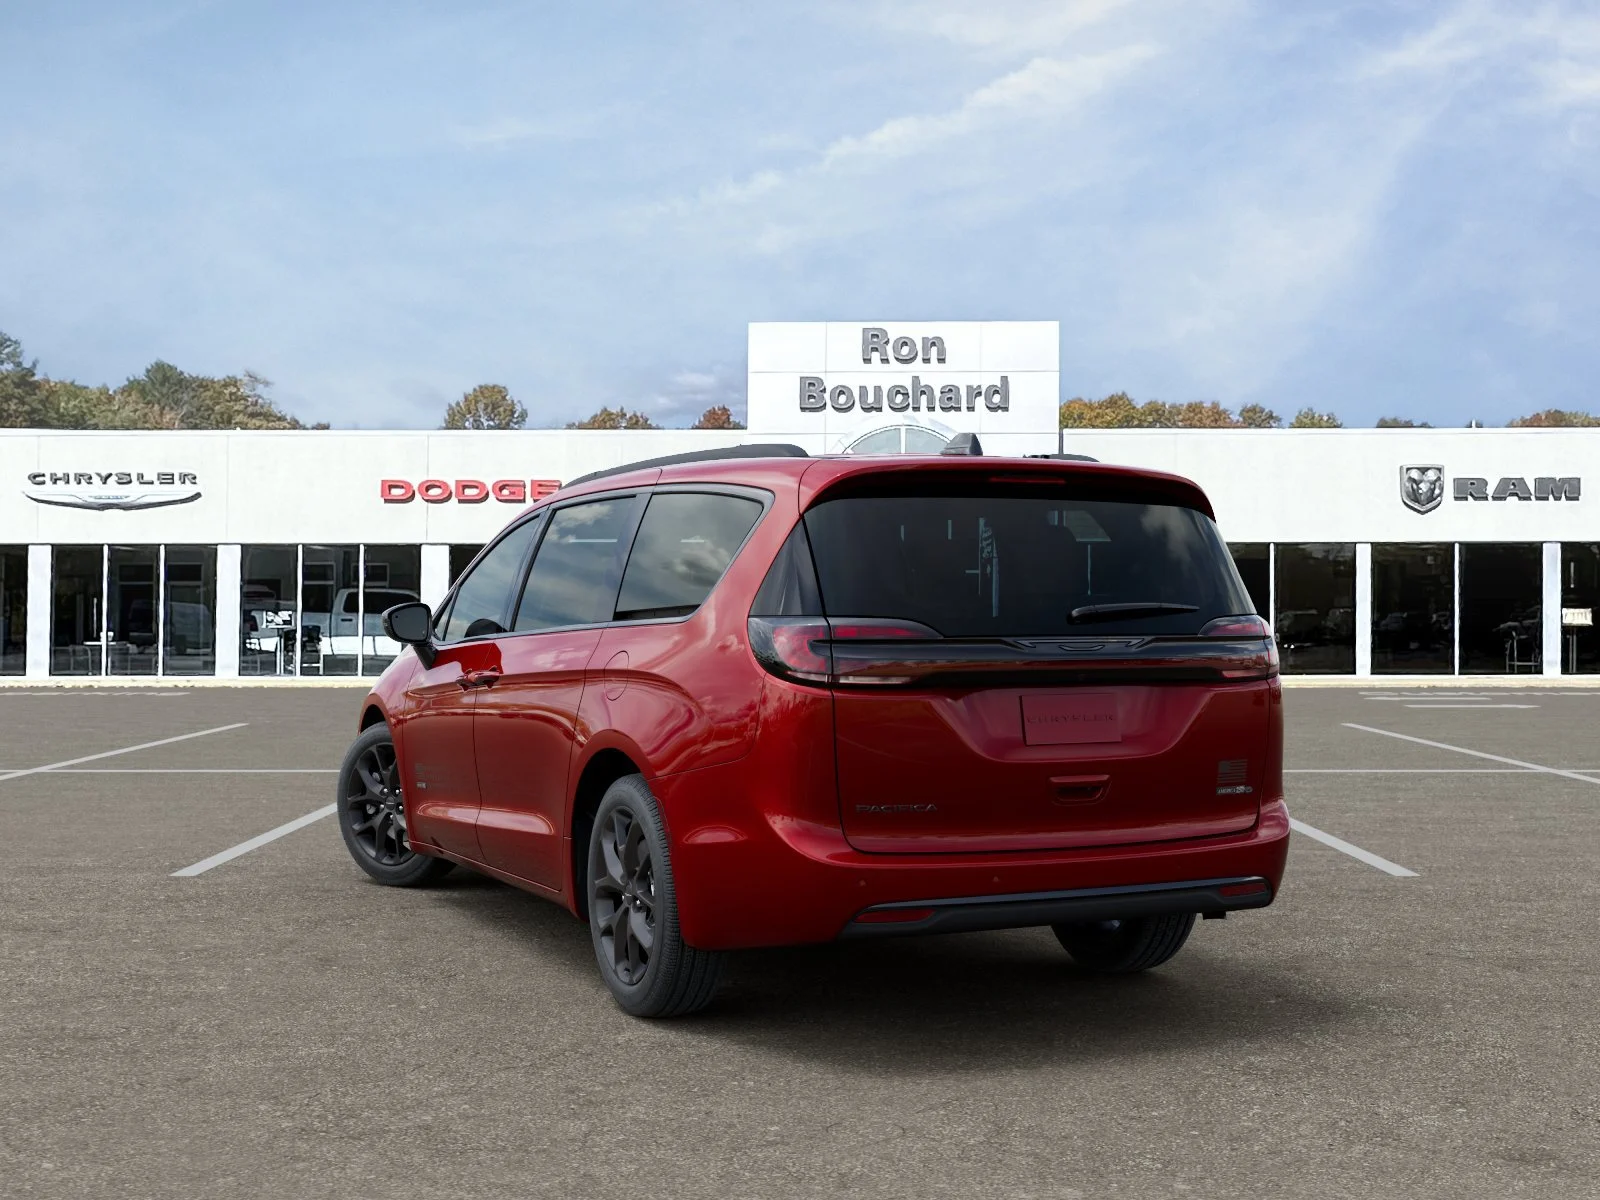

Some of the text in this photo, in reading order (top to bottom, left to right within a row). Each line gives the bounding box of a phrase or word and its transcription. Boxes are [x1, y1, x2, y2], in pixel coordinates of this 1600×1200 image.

[862, 327, 947, 364] Ron
[799, 376, 1010, 413] Bouchard
[28, 472, 198, 485] CHRYSLER
[1453, 477, 1581, 501] RAM
[380, 479, 562, 504] DODGE
[1026, 712, 1117, 724] CHRYSLER
[855, 803, 938, 814] PACIFICA
